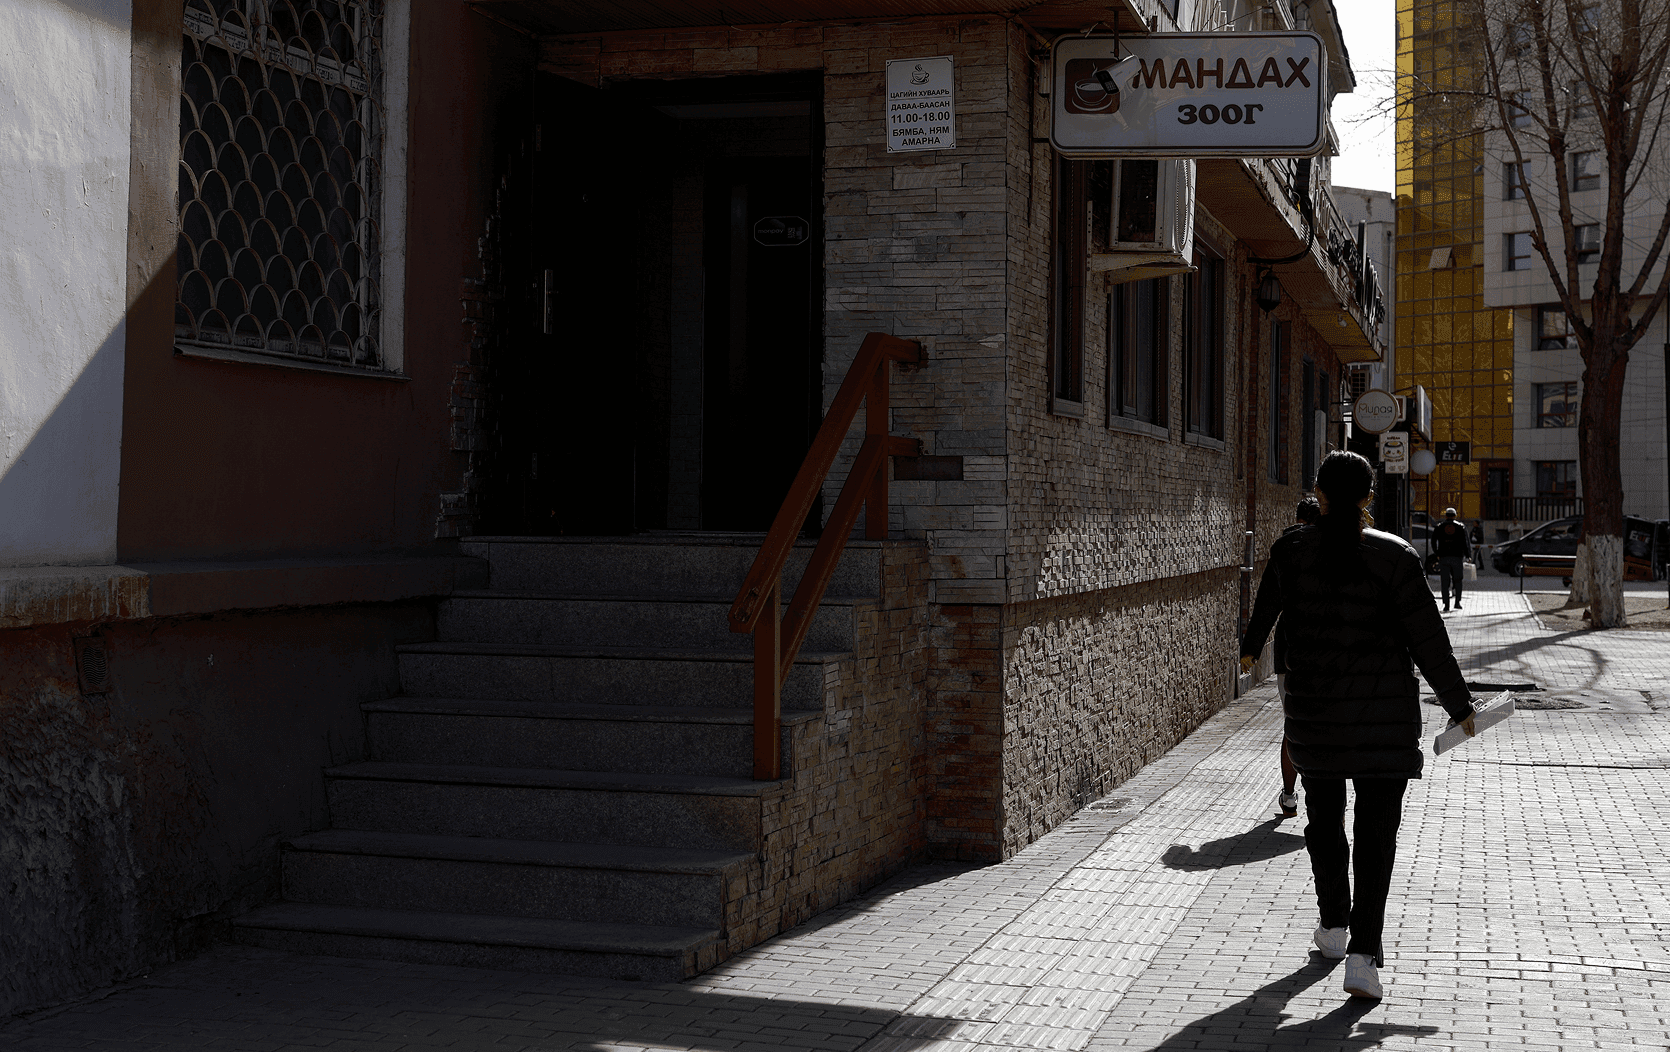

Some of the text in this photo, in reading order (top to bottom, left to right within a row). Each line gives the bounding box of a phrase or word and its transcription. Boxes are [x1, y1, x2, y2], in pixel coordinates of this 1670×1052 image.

[1132, 57, 1310, 89] МАНДАХ
[890, 89, 950, 99] ЦАГИЙН ХУВААРЬ
[890, 101, 950, 112] ДАВАА-БААСАН
[891, 111, 950, 124] 11.00-18.00
[892, 126, 950, 137] БЯМБА, НЯМ
[901, 136, 941, 146] АМАРНА
